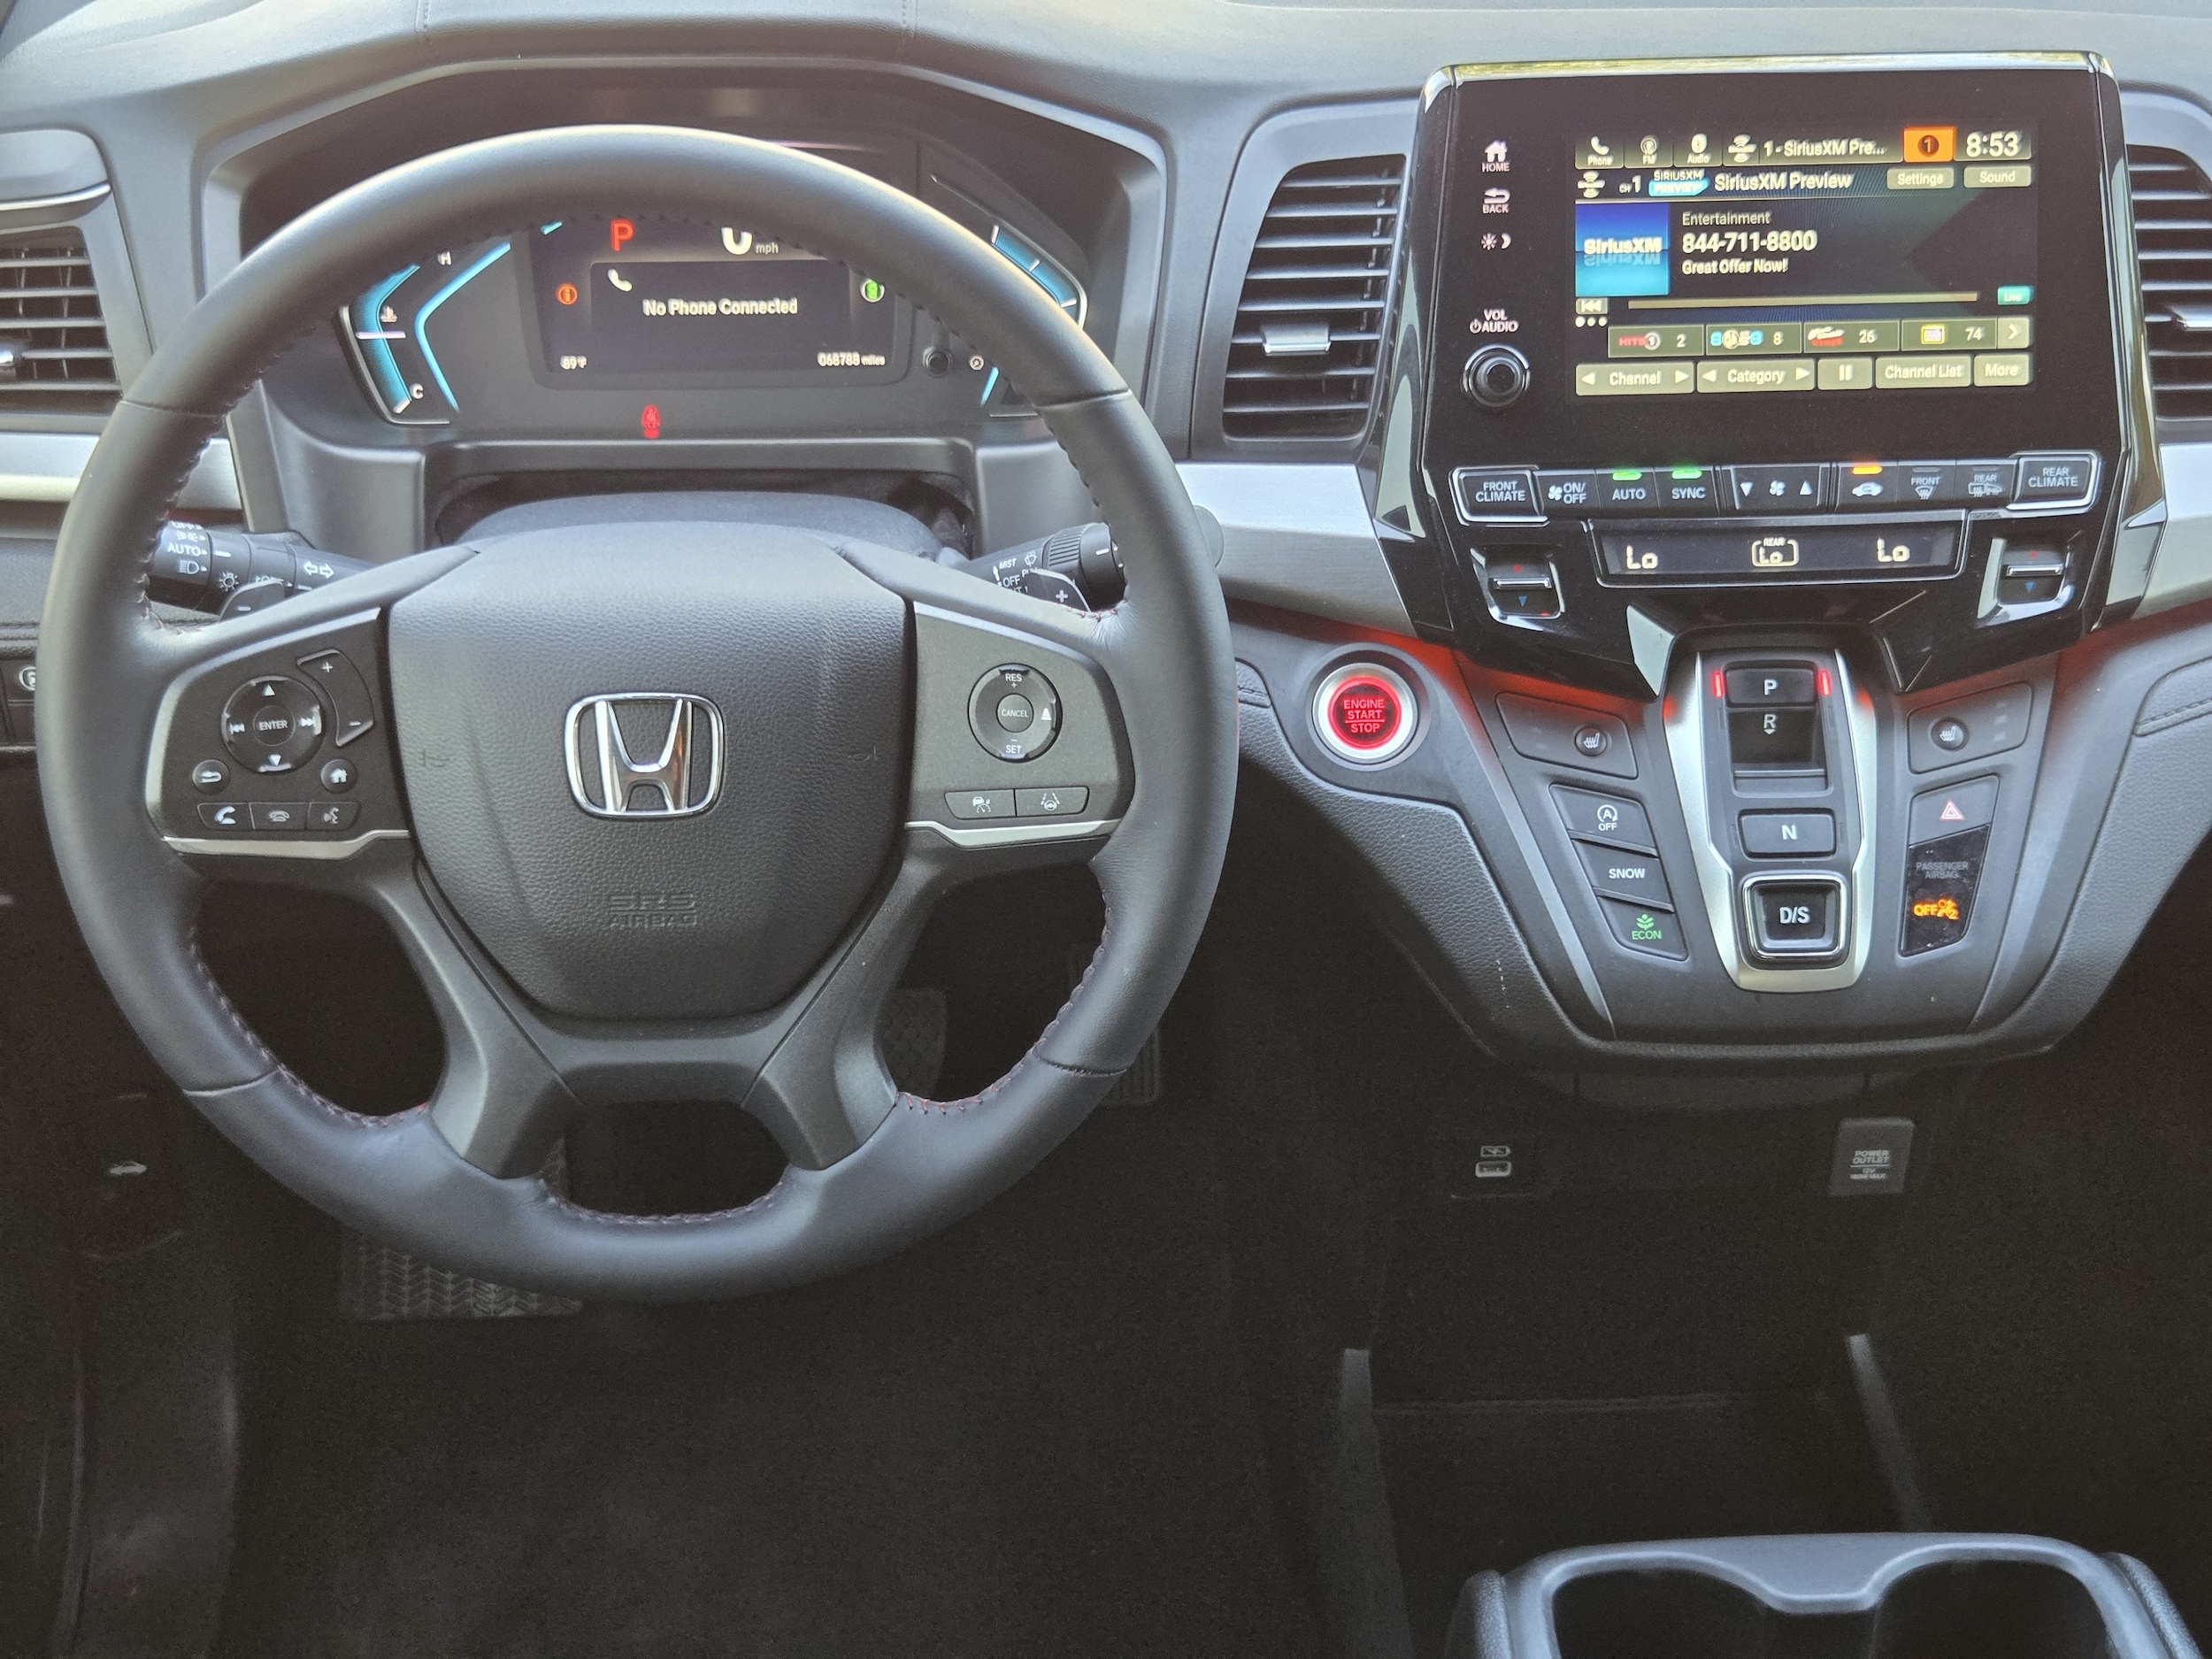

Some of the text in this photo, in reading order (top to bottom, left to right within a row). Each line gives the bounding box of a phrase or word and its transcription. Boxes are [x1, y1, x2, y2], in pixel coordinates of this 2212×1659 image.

[1784, 138, 1848, 157] SiriusXM
[1966, 132, 2024, 157] 8:53
[1587, 155, 1614, 166] Phone
[1642, 155, 1657, 165] FM
[1686, 153, 1711, 165] Audio
[1481, 162, 1510, 173] HOME
[1653, 168, 1705, 181] SIRIUSXM
[1714, 170, 1853, 192] SiriusXM Preview
[1897, 171, 1944, 187] Settings
[1979, 170, 2016, 184] Sound
[1482, 204, 1509, 214] BACK
[1682, 211, 1771, 227] Entertainment
[609, 219, 634, 251] P
[1682, 229, 1817, 254] 844-711-8800
[756, 242, 779, 255] mph
[1583, 237, 1662, 255] SiriusXM
[1682, 257, 1789, 275] Great Offer Now!
[642, 296, 798, 316] No Phone Connected
[1484, 310, 1508, 321] VOL
[1481, 321, 1519, 333] AUDIO
[1676, 333, 1687, 348] 2
[1773, 331, 1784, 346] 8
[1858, 328, 1878, 343] 26
[1964, 326, 1985, 342] 74
[861, 355, 886, 366] miles
[1727, 368, 1785, 385] Category
[1885, 364, 1962, 380] Channel List
[1985, 363, 2019, 377] More
[1609, 372, 1662, 386] Channel
[1973, 474, 1997, 483] REAR
[2042, 467, 2070, 478] REAR
[1483, 481, 1517, 492] FRONT
[1563, 482, 1586, 494] ON/
[1910, 477, 1940, 486] FRONT
[2028, 476, 2078, 488] CLIMATE
[1475, 490, 1526, 503] CLIMATE
[1563, 492, 1586, 504] OFF
[1612, 488, 1647, 501] AUTO
[1671, 487, 1706, 500] SYNC
[1763, 536, 1786, 547] REAR
[167, 541, 202, 557] AUTO
[999, 557, 1018, 570] MIST
[1002, 574, 1020, 588] OFF
[1005, 673, 1023, 682] RES
[1763, 680, 1778, 695] P
[1343, 699, 1385, 710] ENGINE
[1001, 709, 1029, 718] CANCEL
[1348, 710, 1382, 720] START
[257, 720, 288, 732] ENTER
[1763, 713, 1777, 728] R
[1350, 722, 1380, 733] STOP
[1005, 745, 1022, 755] SET
[1598, 821, 1617, 832] OFF
[1781, 825, 1797, 841] N
[1916, 861, 1969, 872] PASSENGER
[1609, 868, 1646, 879] SNOW
[1924, 871, 1960, 879] AIRBAG
[1779, 906, 1810, 925] D/S
[1913, 903, 1939, 917] OFF
[1632, 930, 1662, 941] ECON
